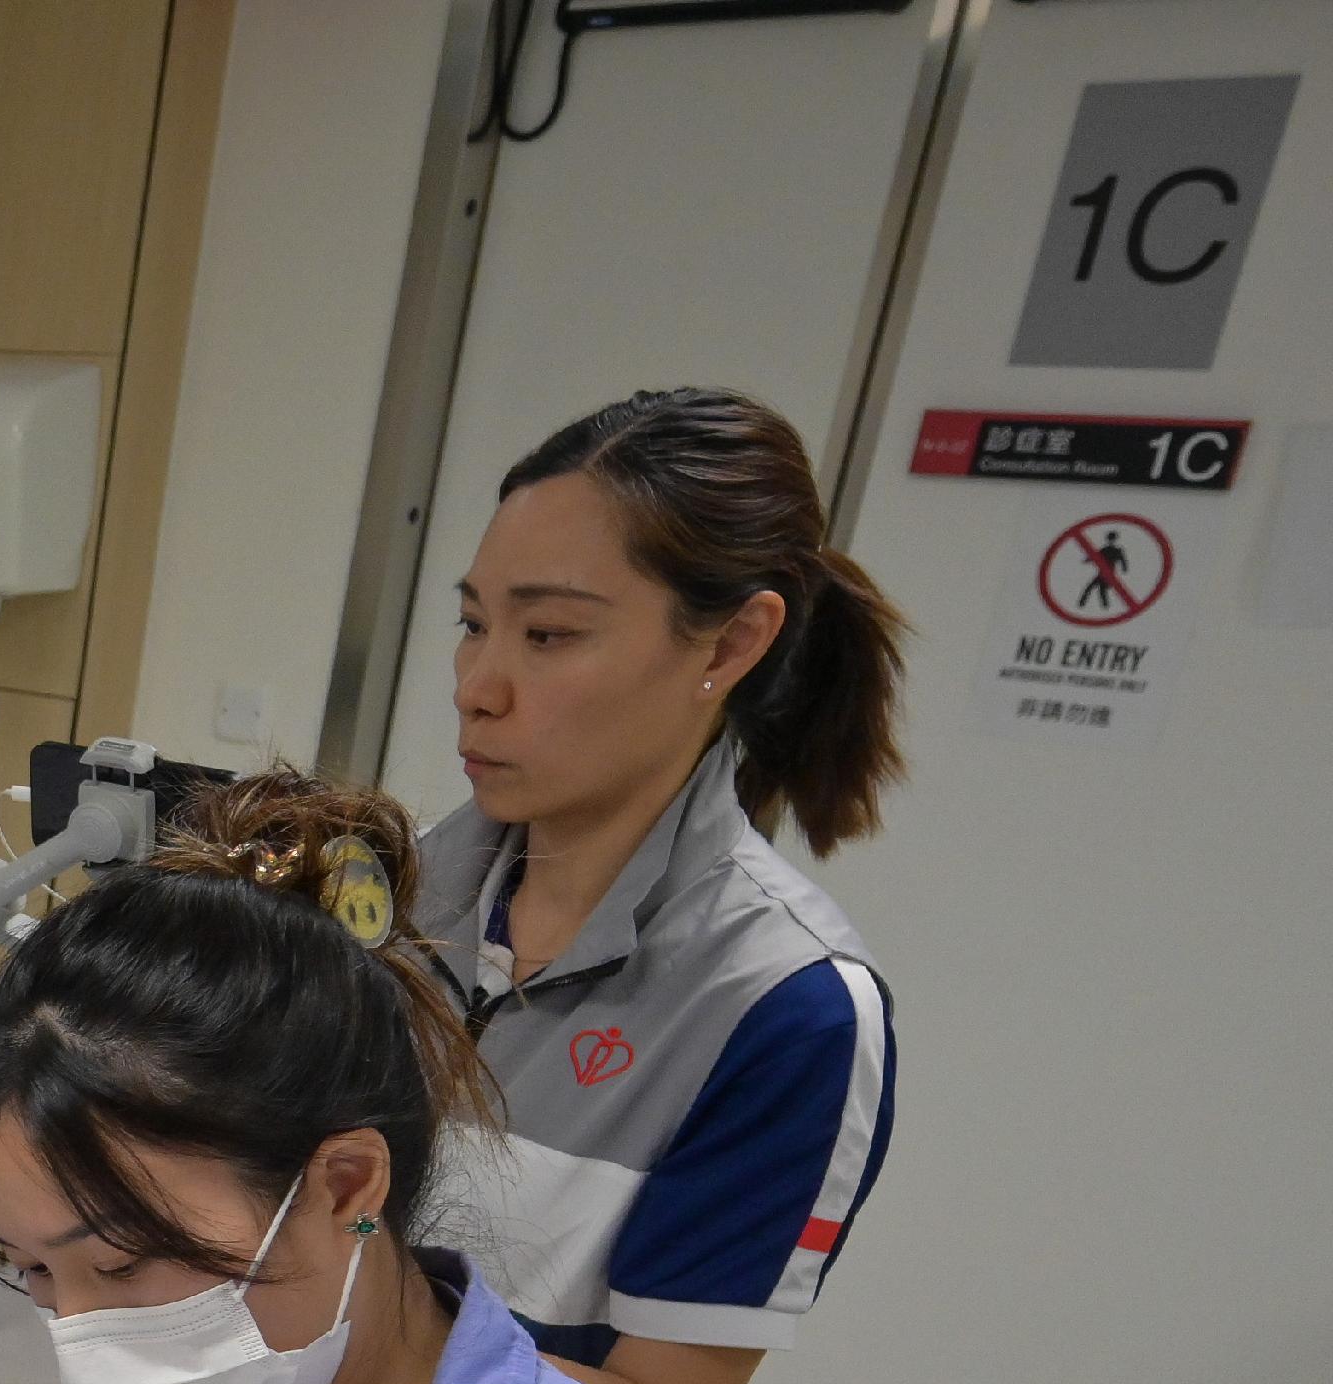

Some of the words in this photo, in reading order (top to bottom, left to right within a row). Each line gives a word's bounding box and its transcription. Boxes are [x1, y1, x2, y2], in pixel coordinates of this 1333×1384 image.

[1069, 166, 1238, 286] 1C
[1149, 431, 1229, 482] 1C
[1015, 634, 1055, 665] NO
[1060, 639, 1148, 673] ENTRY
